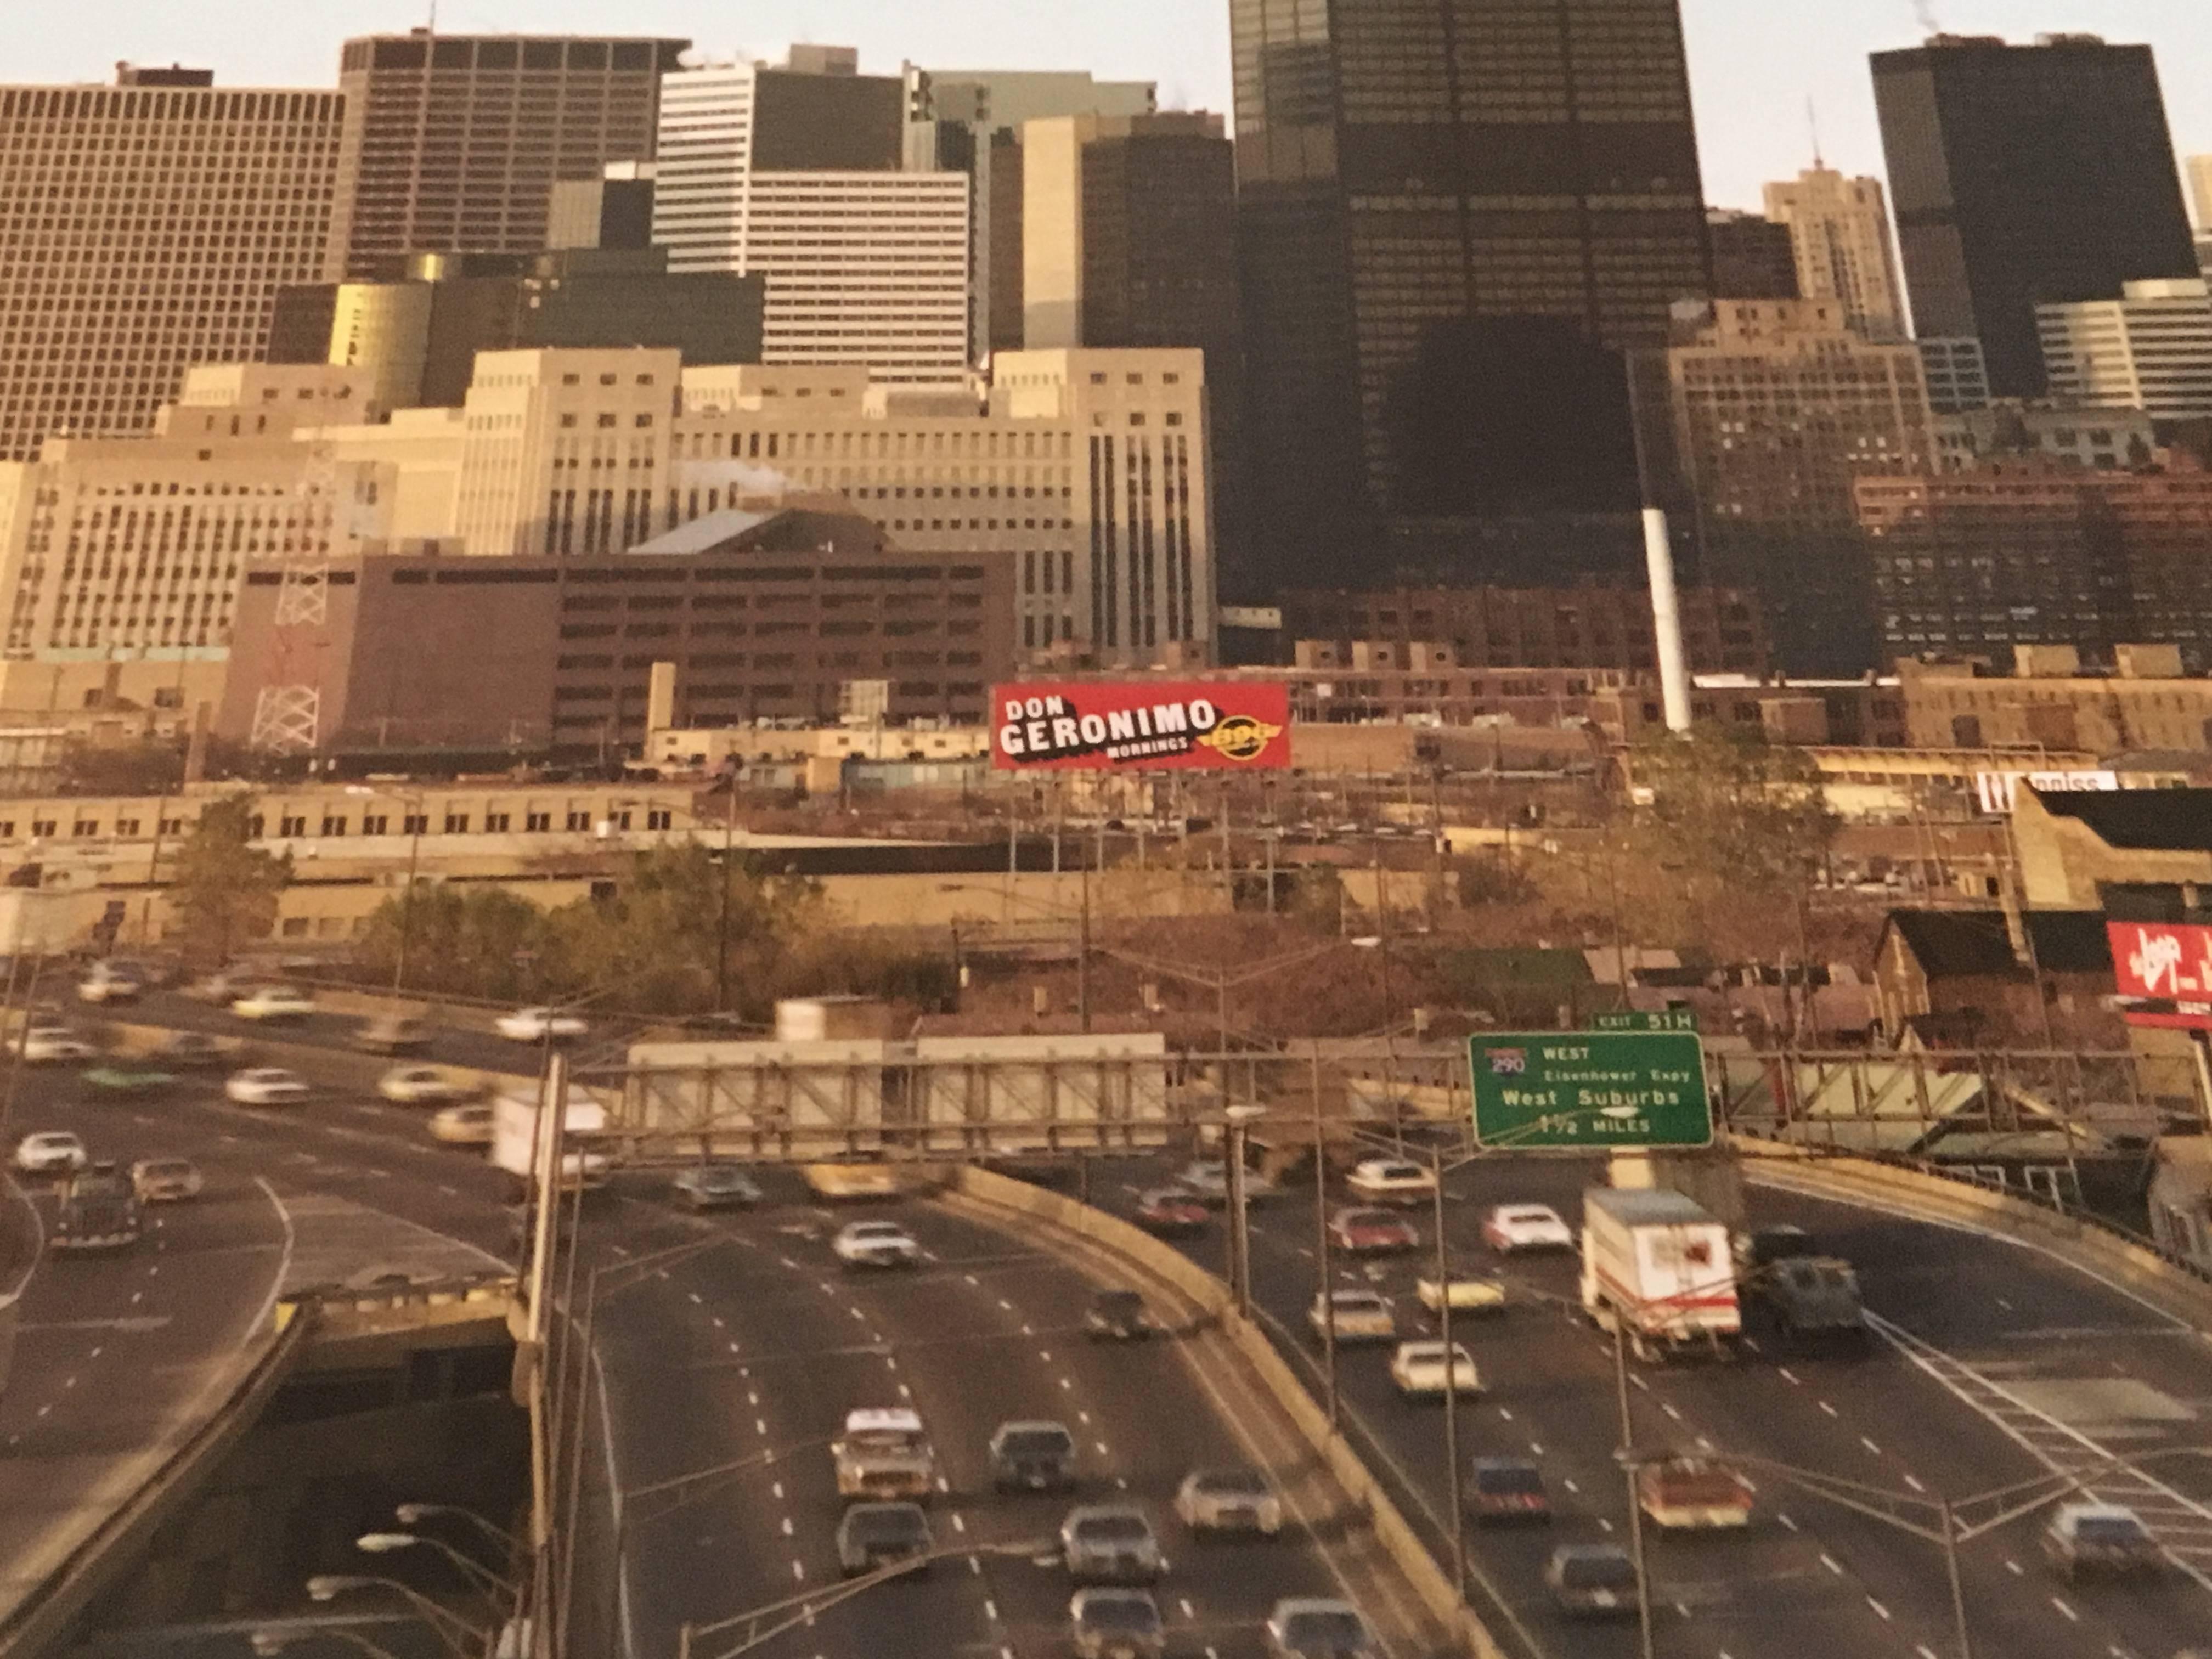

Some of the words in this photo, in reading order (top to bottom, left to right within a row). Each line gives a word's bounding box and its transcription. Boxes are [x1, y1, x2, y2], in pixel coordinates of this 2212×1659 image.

[1005, 695, 1063, 721] DON
[1000, 699, 1216, 755] GERONIMO
[1107, 736, 1188, 759] MORNINGS
[1543, 1047, 1589, 1060] WEST
[1492, 1057, 1526, 1073] 290
[1544, 1070, 1637, 1082] Eisenhower
[1502, 1090, 1558, 1106] West
[1578, 1088, 1680, 1106] Suburbs
[1593, 1118, 1650, 1133] MILES
